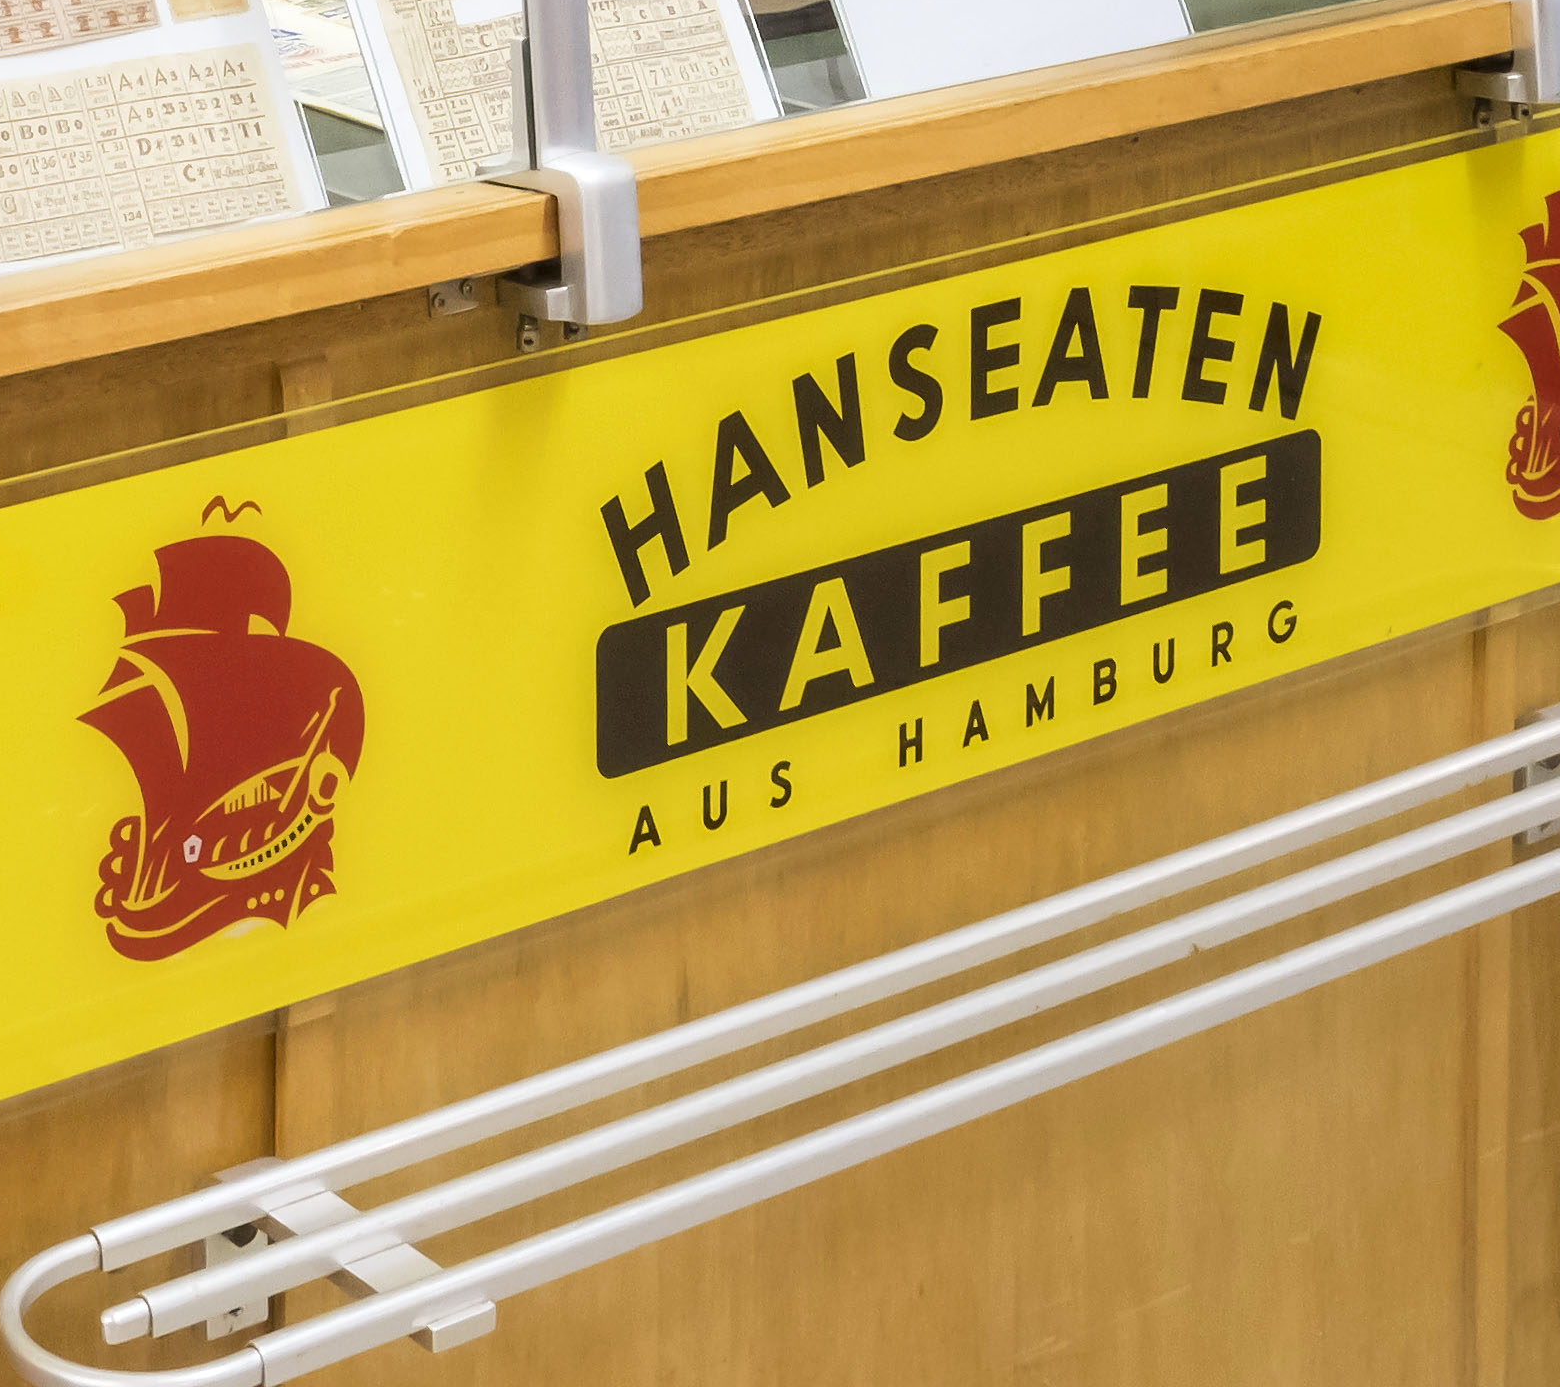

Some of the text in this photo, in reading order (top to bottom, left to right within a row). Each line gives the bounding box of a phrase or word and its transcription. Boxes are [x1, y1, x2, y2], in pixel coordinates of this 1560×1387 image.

[600, 285, 1322, 609] HANSEATEN
[628, 599, 1298, 856] AUS HAMBURG
[666, 454, 1268, 746] KAFFEE
